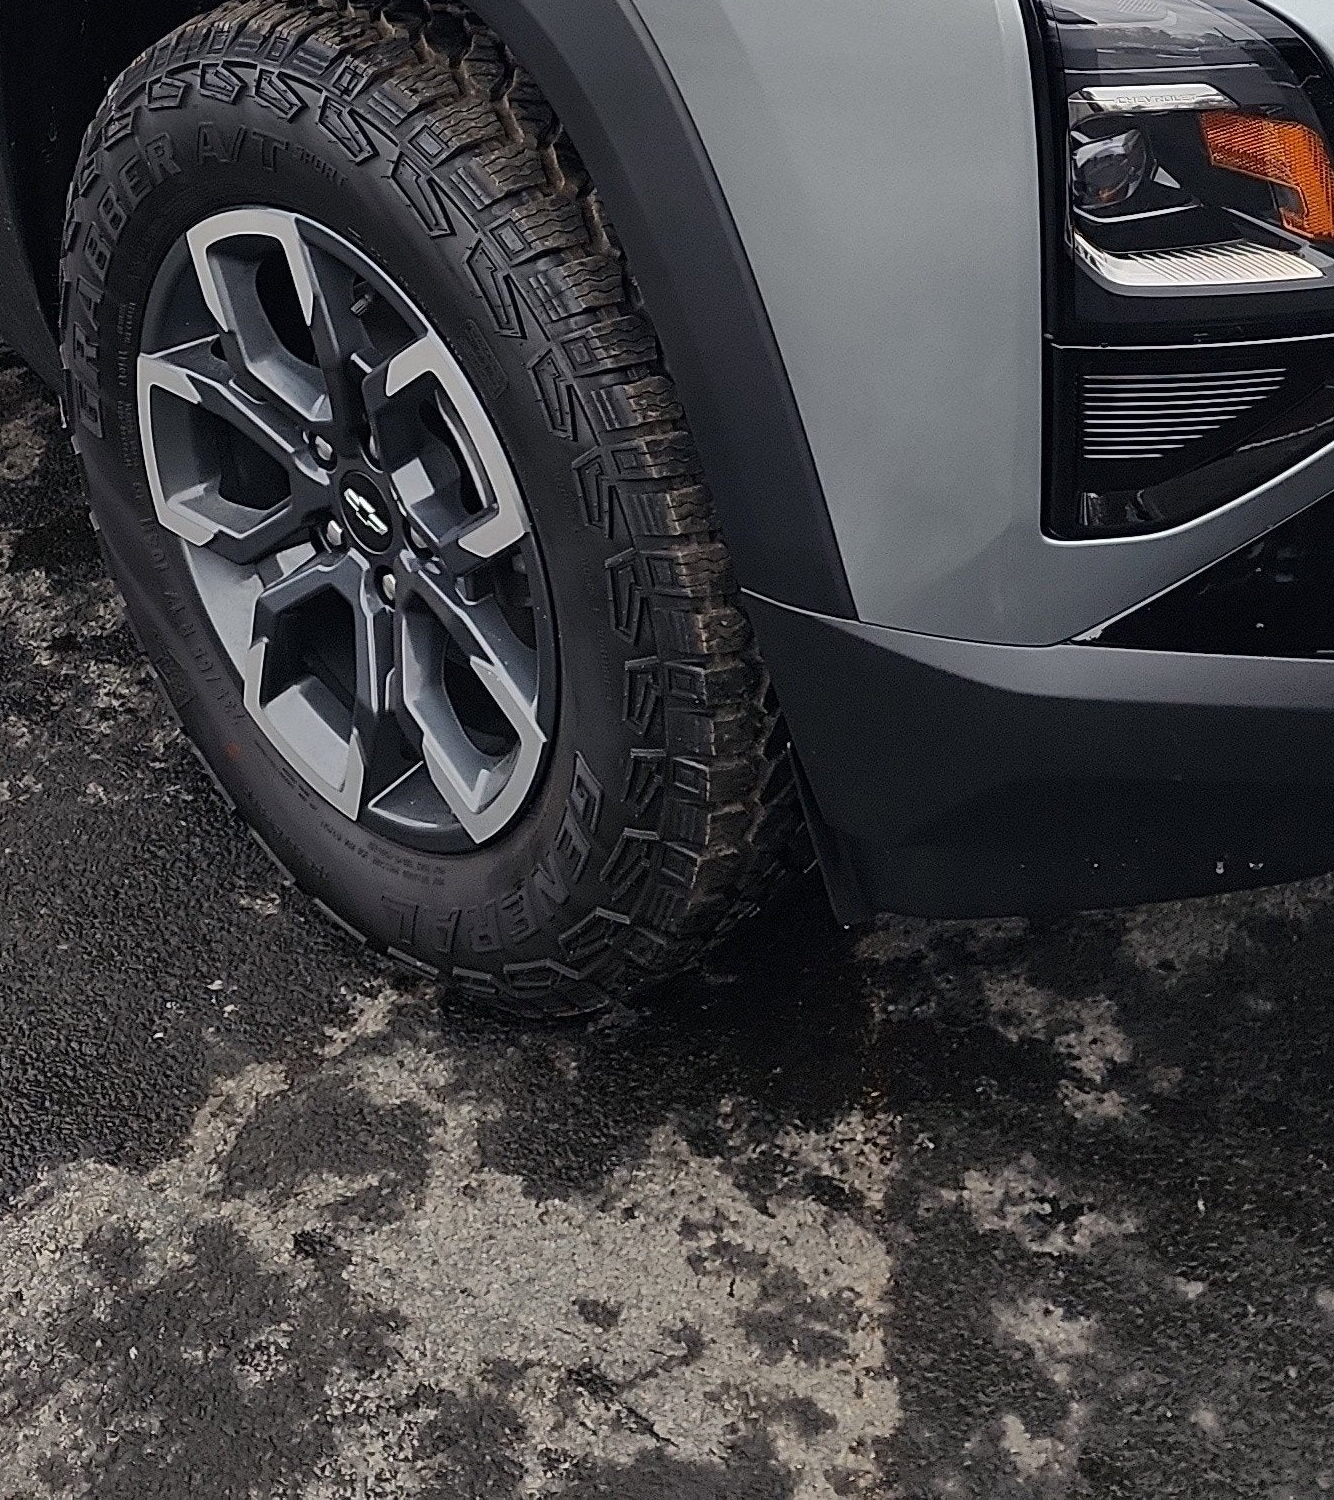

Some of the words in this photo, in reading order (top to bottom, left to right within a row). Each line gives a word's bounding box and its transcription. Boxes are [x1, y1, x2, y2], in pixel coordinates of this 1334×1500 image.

[1115, 93, 1198, 104] CHEVROLET
[72, 131, 182, 438] GRABBER
[197, 121, 289, 171] A/T
[381, 750, 606, 951] GENERAL
